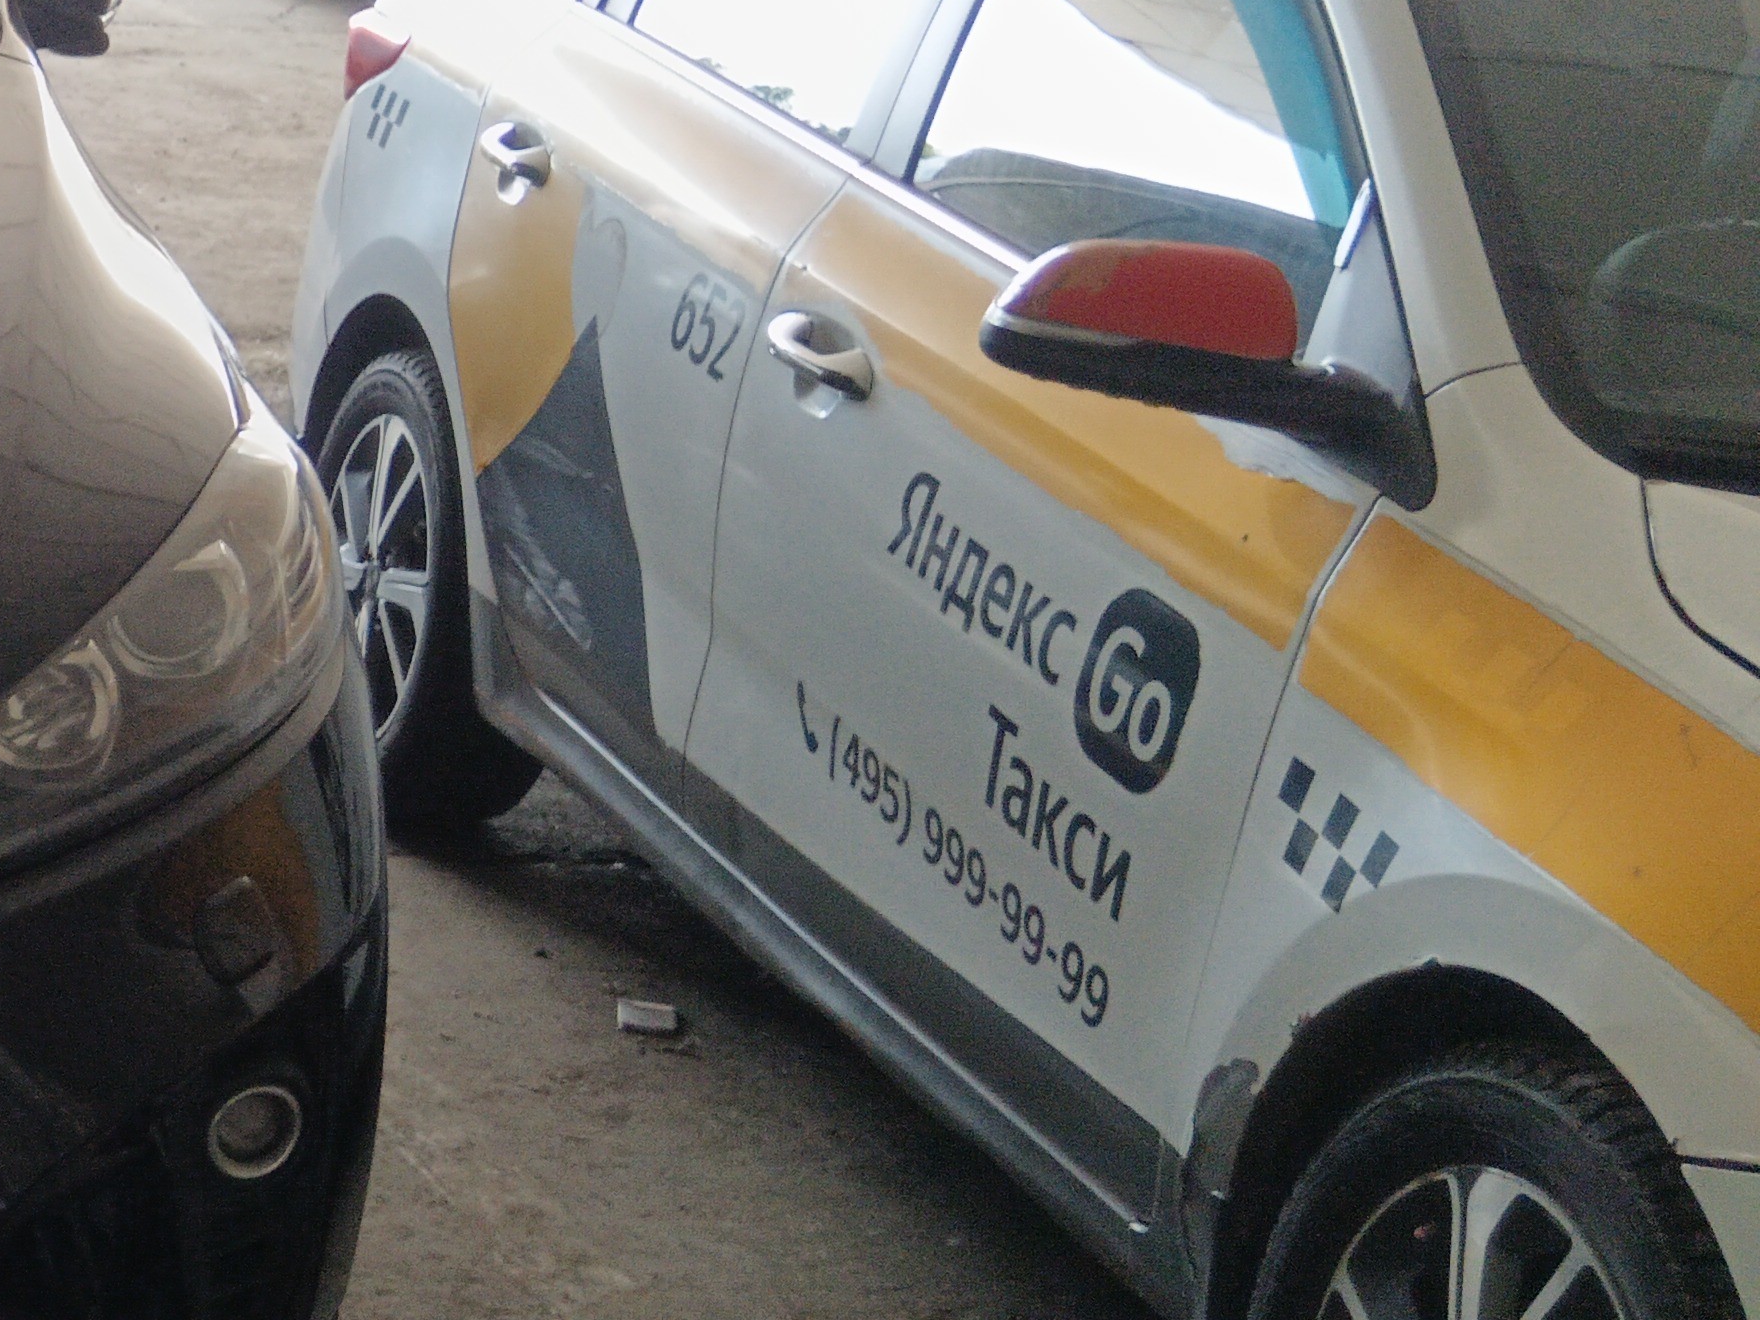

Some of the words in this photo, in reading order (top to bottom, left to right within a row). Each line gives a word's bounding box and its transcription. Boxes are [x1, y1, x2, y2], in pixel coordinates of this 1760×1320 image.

[668, 274, 748, 384] 652
[885, 471, 1079, 688] Яндекс
[1088, 624, 1173, 763] Go
[828, 713, 915, 847] (495)
[922, 805, 1111, 1029] 999-99-99
[984, 703, 1133, 924] Такси
